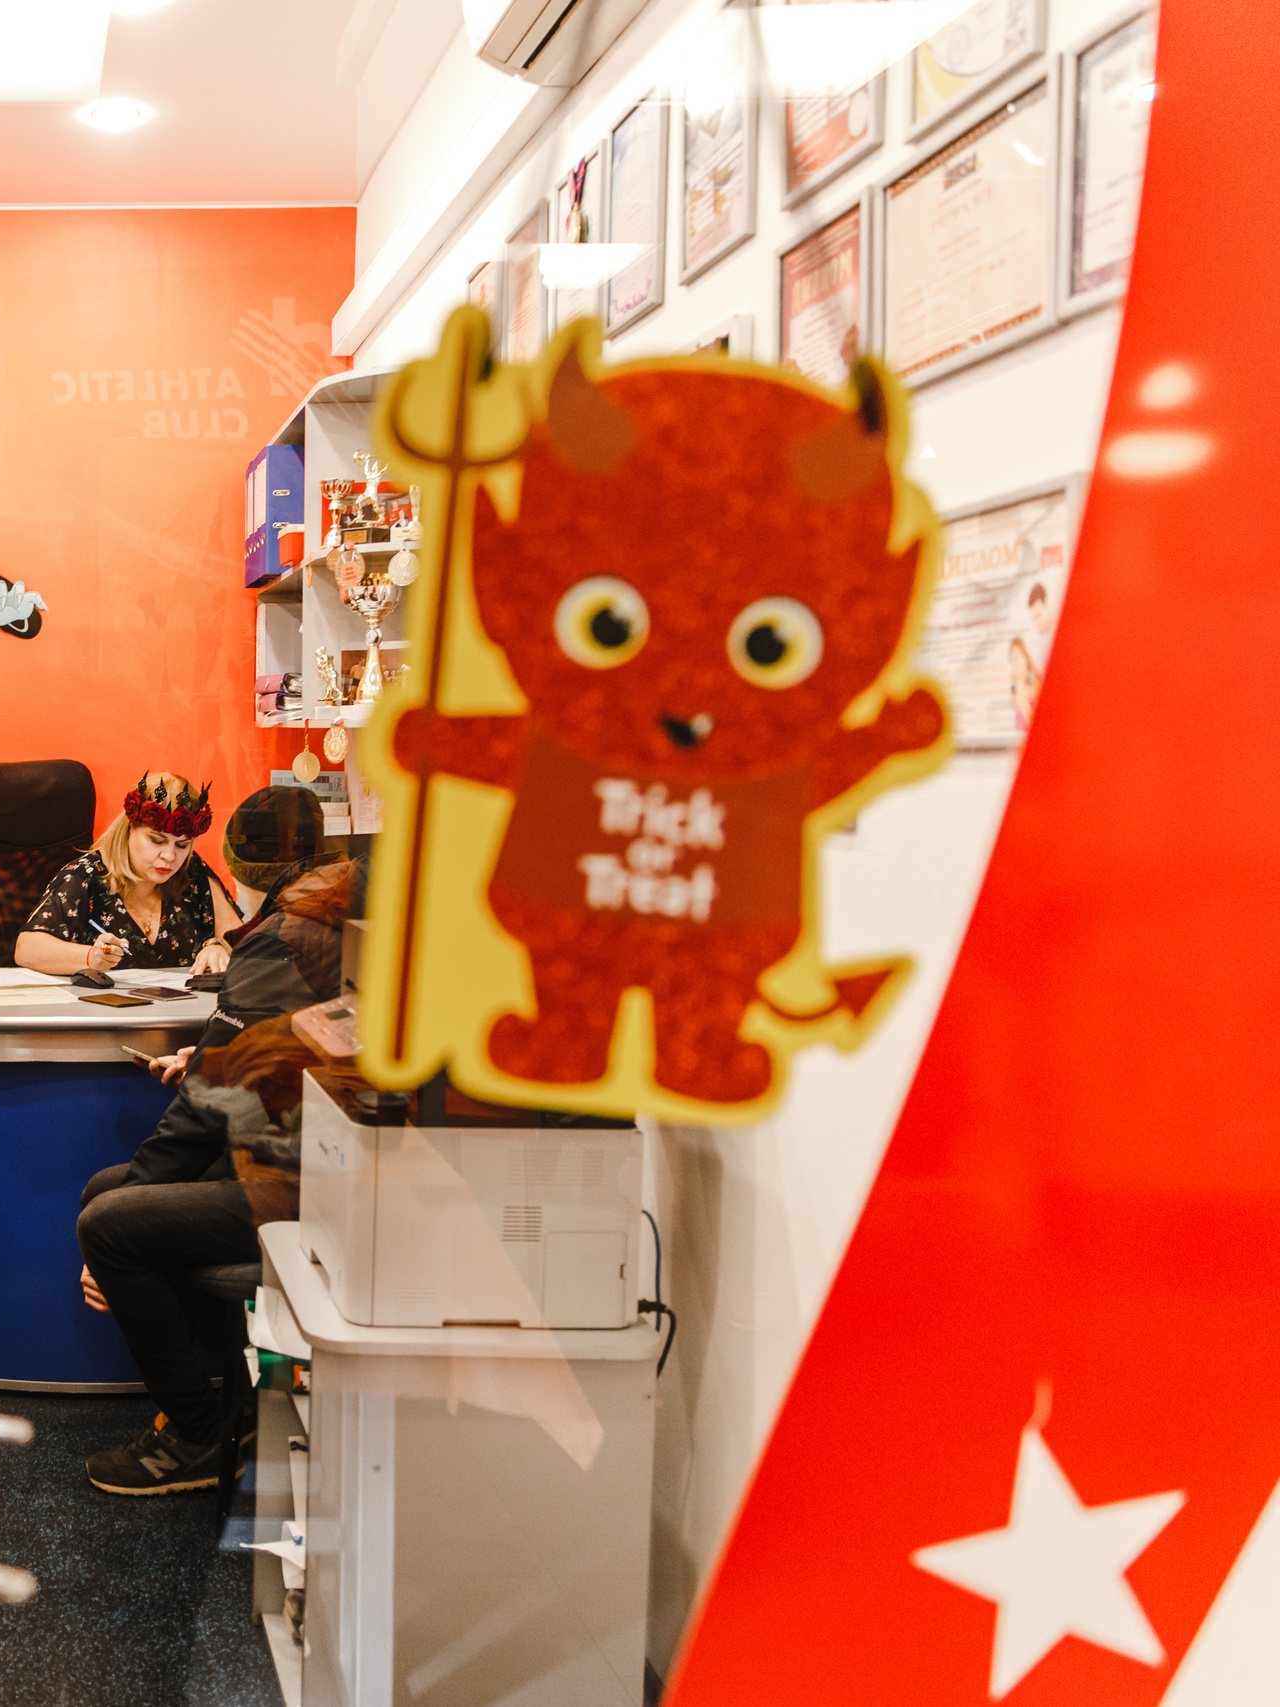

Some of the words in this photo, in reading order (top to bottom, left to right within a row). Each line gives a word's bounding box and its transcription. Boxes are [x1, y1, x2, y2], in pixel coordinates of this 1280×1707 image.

[593, 778, 726, 850] Trick
[577, 853, 719, 923] Treat
[213, 1009, 245, 1029] Columbia
